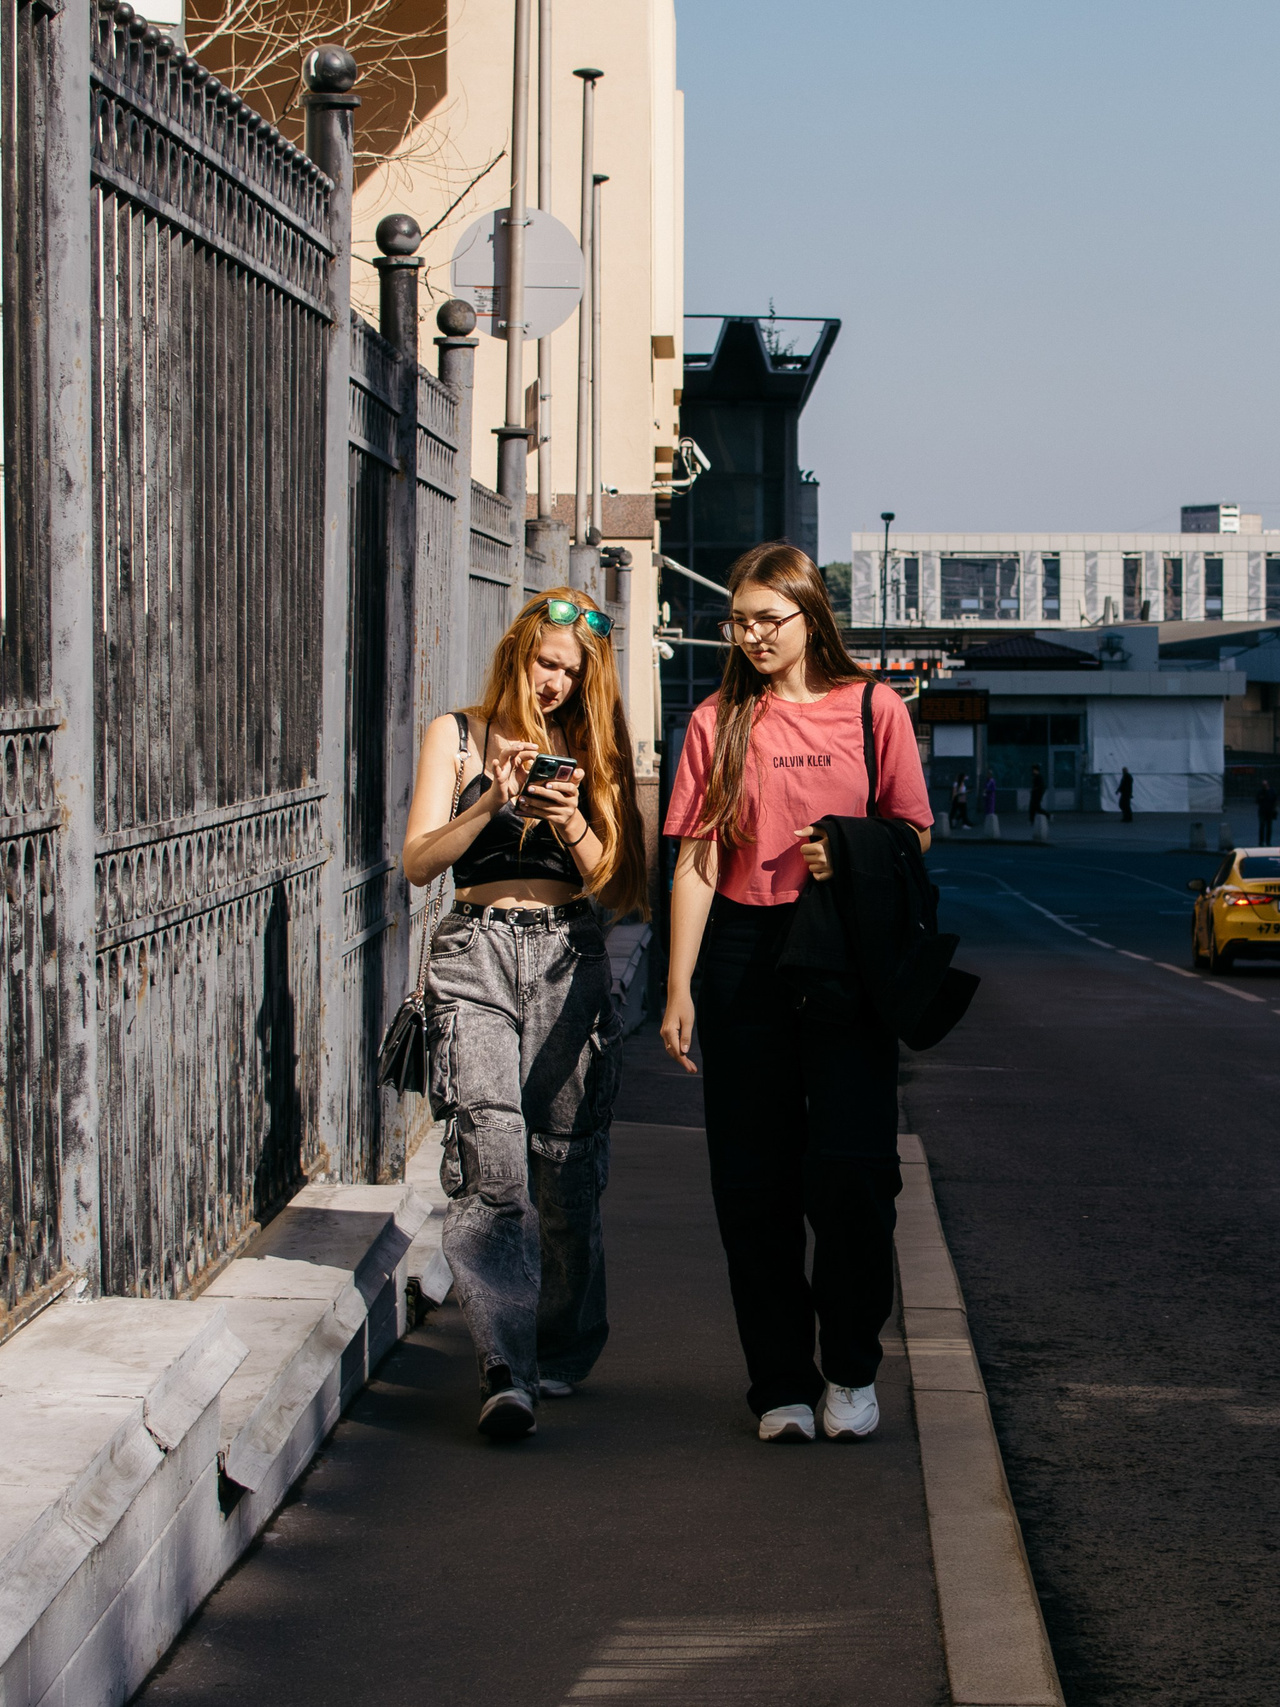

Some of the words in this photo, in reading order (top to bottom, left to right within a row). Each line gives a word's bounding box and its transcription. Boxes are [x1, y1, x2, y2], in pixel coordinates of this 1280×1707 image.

[773, 756, 804, 768] CALVIN
[807, 755, 831, 767] KLEIN
[1257, 924, 1271, 934] +7
